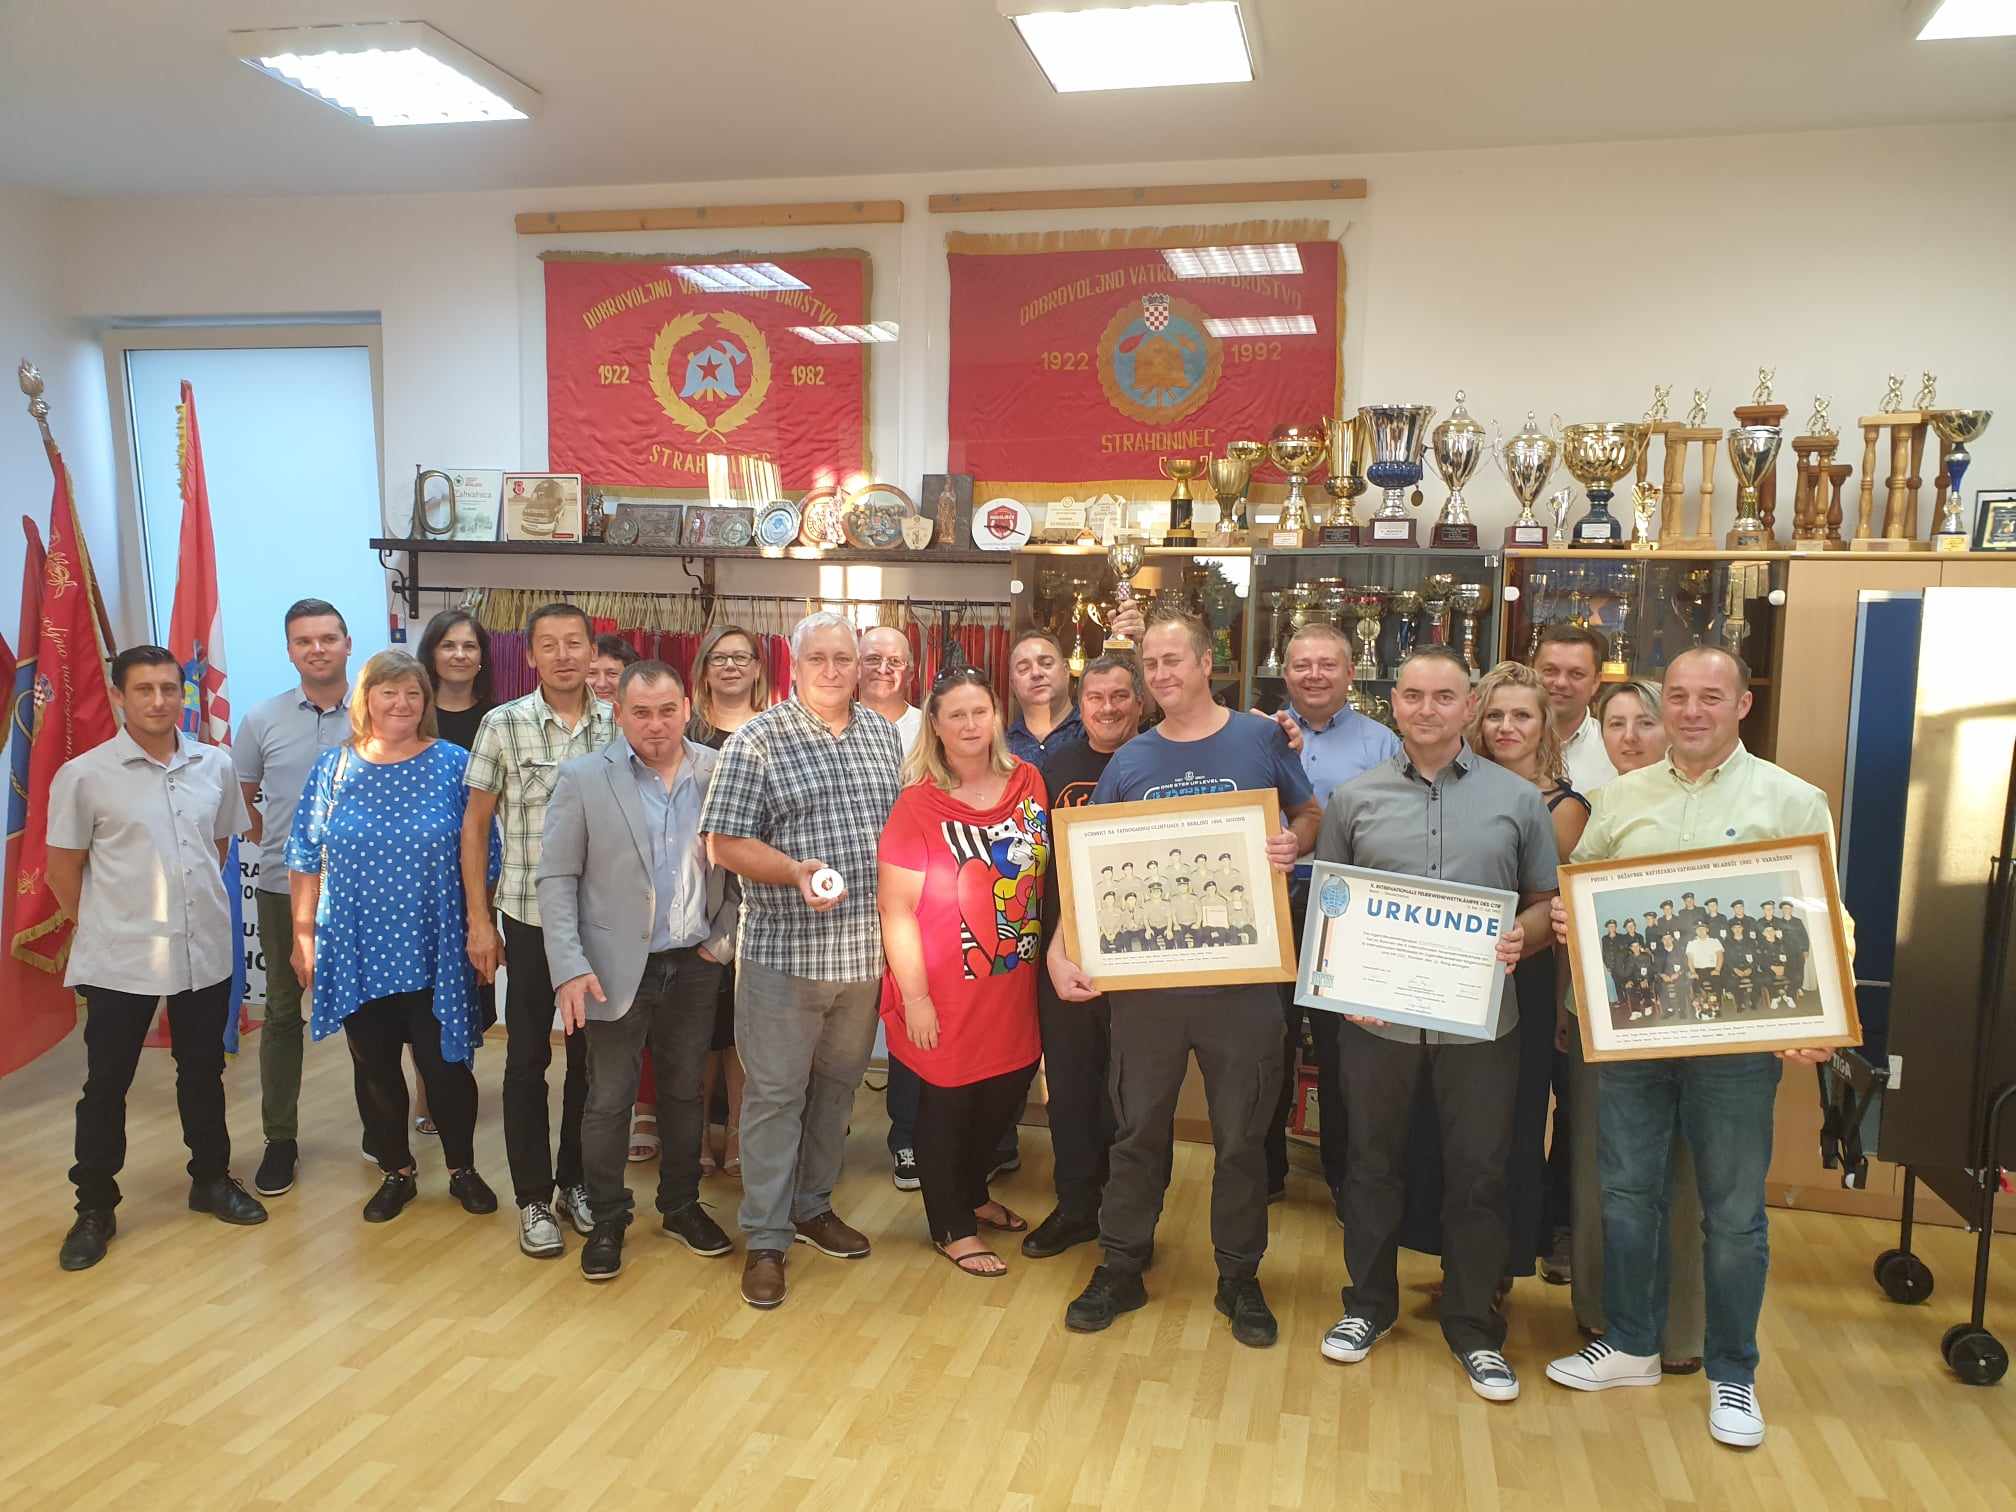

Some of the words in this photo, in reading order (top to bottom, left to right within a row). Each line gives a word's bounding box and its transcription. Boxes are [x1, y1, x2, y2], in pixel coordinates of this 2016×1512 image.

[582, 279, 672, 331] DOBROVOLJNO
[1040, 351, 1089, 371] 1922
[1232, 341, 1283, 363] 1992
[598, 364, 631, 385] 1922
[791, 365, 825, 386] 1982
[1101, 429, 1215, 454] STRAHONINEC
[1366, 898, 1500, 937] URKUNDE
